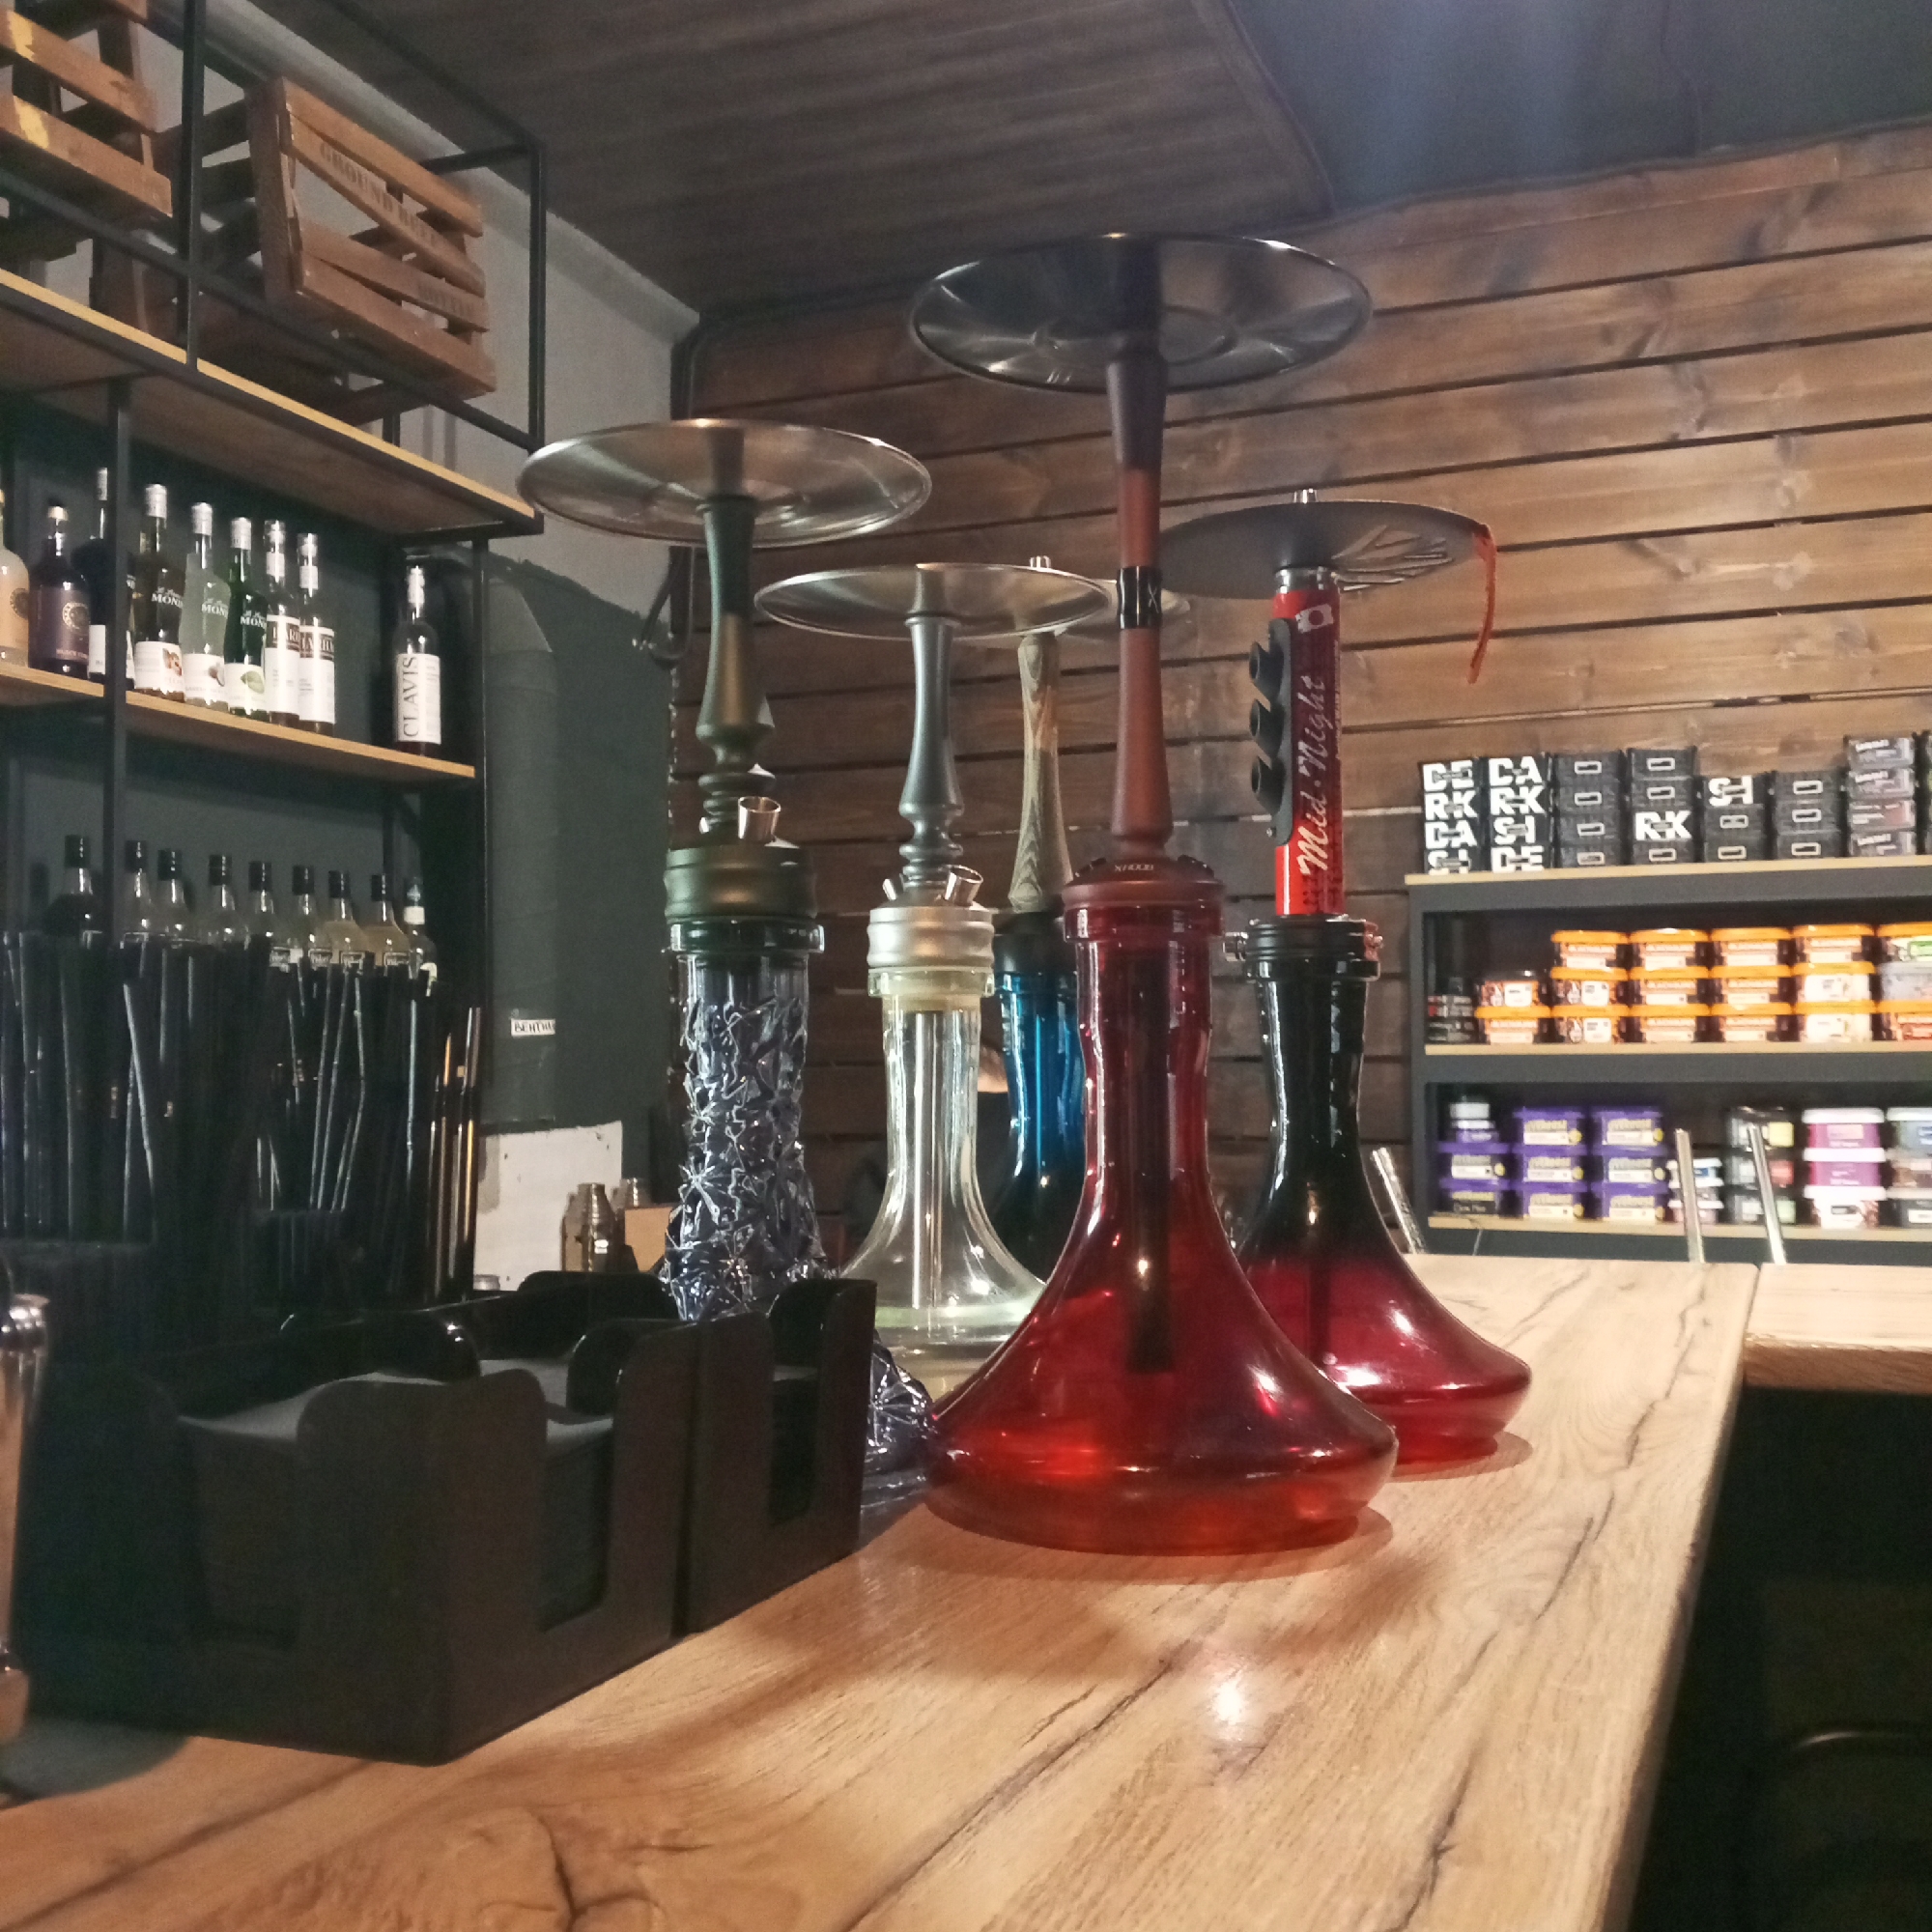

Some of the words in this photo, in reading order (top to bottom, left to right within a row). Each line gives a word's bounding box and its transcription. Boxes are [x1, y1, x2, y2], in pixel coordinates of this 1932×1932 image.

[402, 657, 419, 737] CLAVIS
[1425, 790, 1478, 821] RK
[1490, 784, 1547, 815] RK
[1635, 810, 1691, 841] RK
